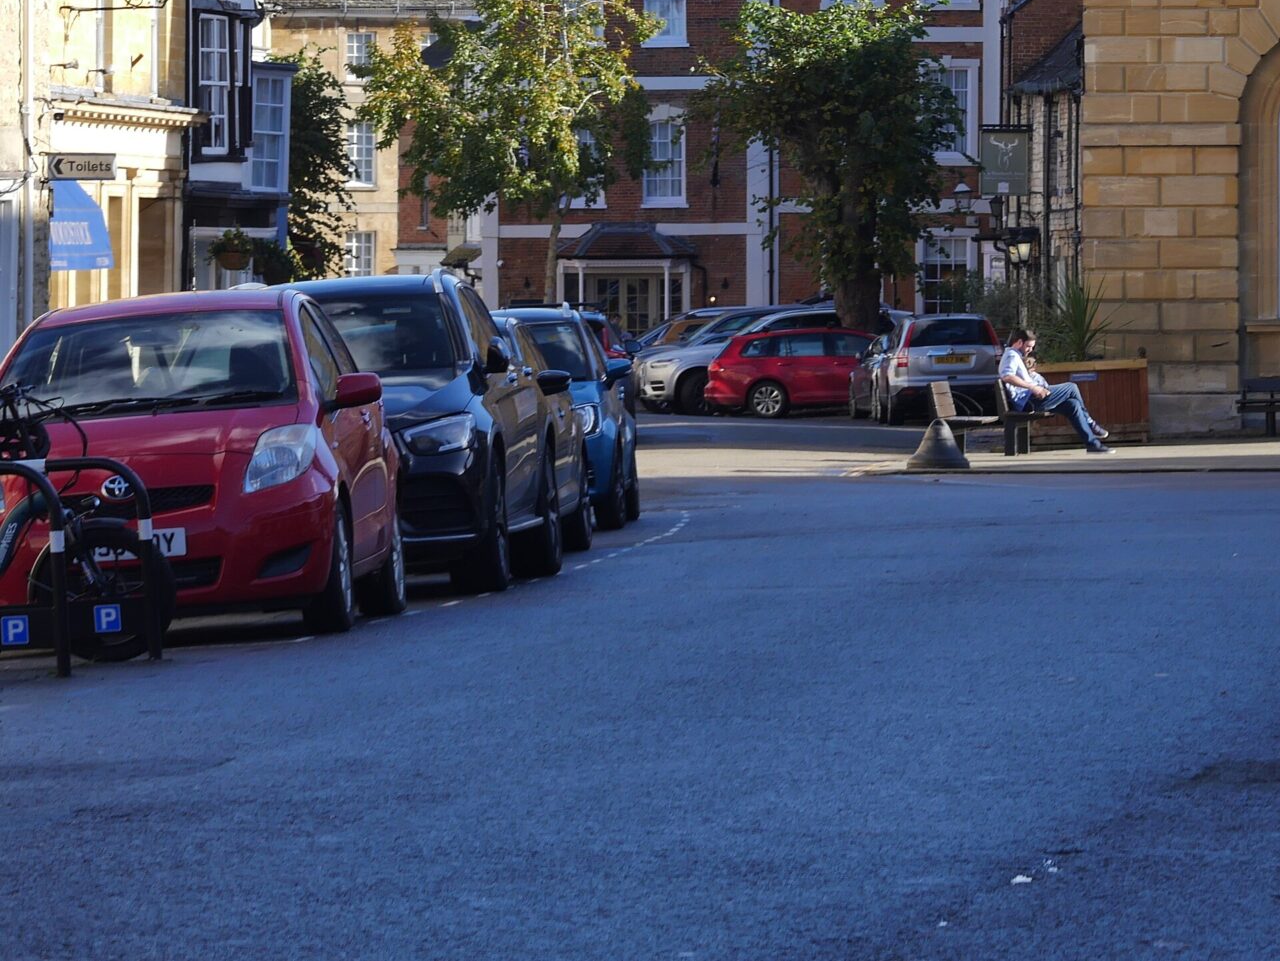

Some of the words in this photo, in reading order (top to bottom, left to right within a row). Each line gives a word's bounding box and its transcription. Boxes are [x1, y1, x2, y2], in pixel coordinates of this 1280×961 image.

[67, 160, 112, 172] Toilets
[101, 608, 117, 630] P
[8, 620, 24, 642] P
